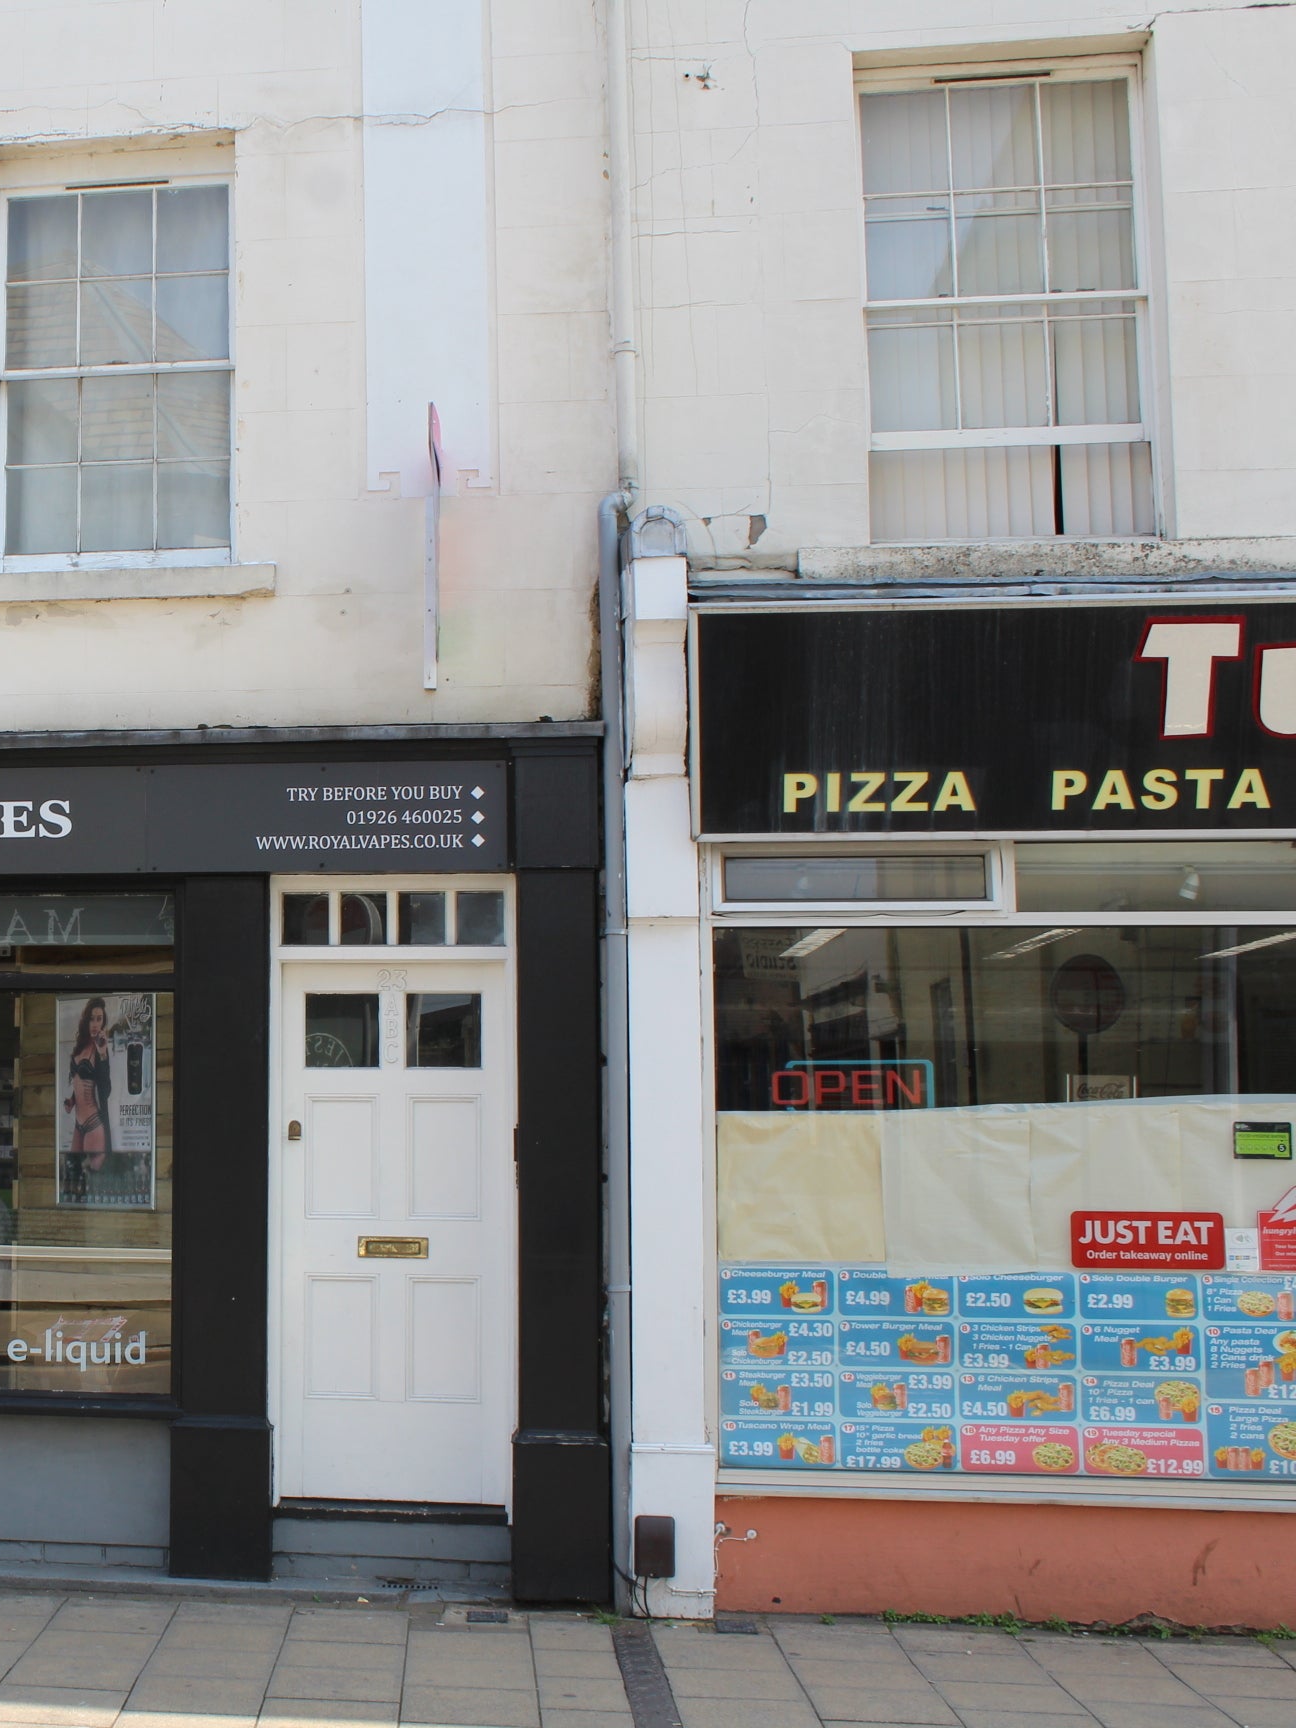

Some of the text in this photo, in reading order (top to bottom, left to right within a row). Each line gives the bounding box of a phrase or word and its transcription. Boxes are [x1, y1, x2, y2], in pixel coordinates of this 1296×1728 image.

[287, 785, 463, 801] TRY BEFORE YOU BUY
[783, 768, 1271, 813] PIZZA PASTA
[346, 809, 462, 824] 01926 460025
[256, 834, 464, 850] WWW.ROYALVAPES.CO.UK
[377, 969, 408, 992] 23
[772, 1070, 921, 1105] OPEN
[1078, 1220, 1214, 1245] JUST EAT
[1086, 1250, 1208, 1262] Order takeaway online
[731, 1270, 800, 1279] Cheeseburger
[993, 1274, 1063, 1282] Cheeseburger
[1153, 1275, 1188, 1284] Burger
[1241, 1275, 1283, 1284] Collection
[727, 1289, 772, 1304] £3.99
[846, 1291, 891, 1305] £4.99
[966, 1292, 1011, 1307] £2.50
[1088, 1294, 1133, 1308] £2.99
[731, 1321, 782, 1330] Chickenburger
[789, 1323, 833, 1337] £4.30
[851, 1322, 943, 1331] Tower Burger Meal
[1016, 1325, 1041, 1333] Strips
[1103, 1326, 1140, 1335] Nugget
[1016, 1335, 1052, 1343] Nuggets
[1210, 1338, 1260, 1347] Any pasta
[7, 1328, 146, 1373] e-liquid
[846, 1341, 890, 1356] £4.50
[1220, 1346, 1263, 1355] Nuggets
[731, 1358, 783, 1366] Chickenburger
[788, 1351, 832, 1366] £2.50
[963, 1353, 1009, 1368] £3.99
[1149, 1356, 1196, 1371] £3.99
[739, 1371, 786, 1380] Steakburger
[791, 1373, 833, 1387] £3.50
[856, 1373, 902, 1382] Veggieburger
[908, 1374, 952, 1389] £3.99
[988, 1375, 1059, 1384] Chicken Strips
[791, 1402, 833, 1416] £1.99
[907, 1403, 952, 1418] £2.50
[962, 1401, 1007, 1416] £4.50
[1089, 1405, 1136, 1421] £6.99
[1229, 1415, 1259, 1423] Large
[737, 1422, 831, 1431] Tuscano Wrap Meal
[979, 1426, 997, 1435] Any
[1028, 1427, 1046, 1436] Any
[1239, 1423, 1263, 1431] fries
[980, 1435, 1047, 1444] Tuesday offer
[1102, 1430, 1176, 1439] Tuesday special
[1239, 1432, 1265, 1440] cans
[729, 1441, 774, 1456] £3.99
[846, 1455, 901, 1469] £17.99
[970, 1450, 1016, 1465] £6.99
[1147, 1459, 1203, 1474] £12.99
